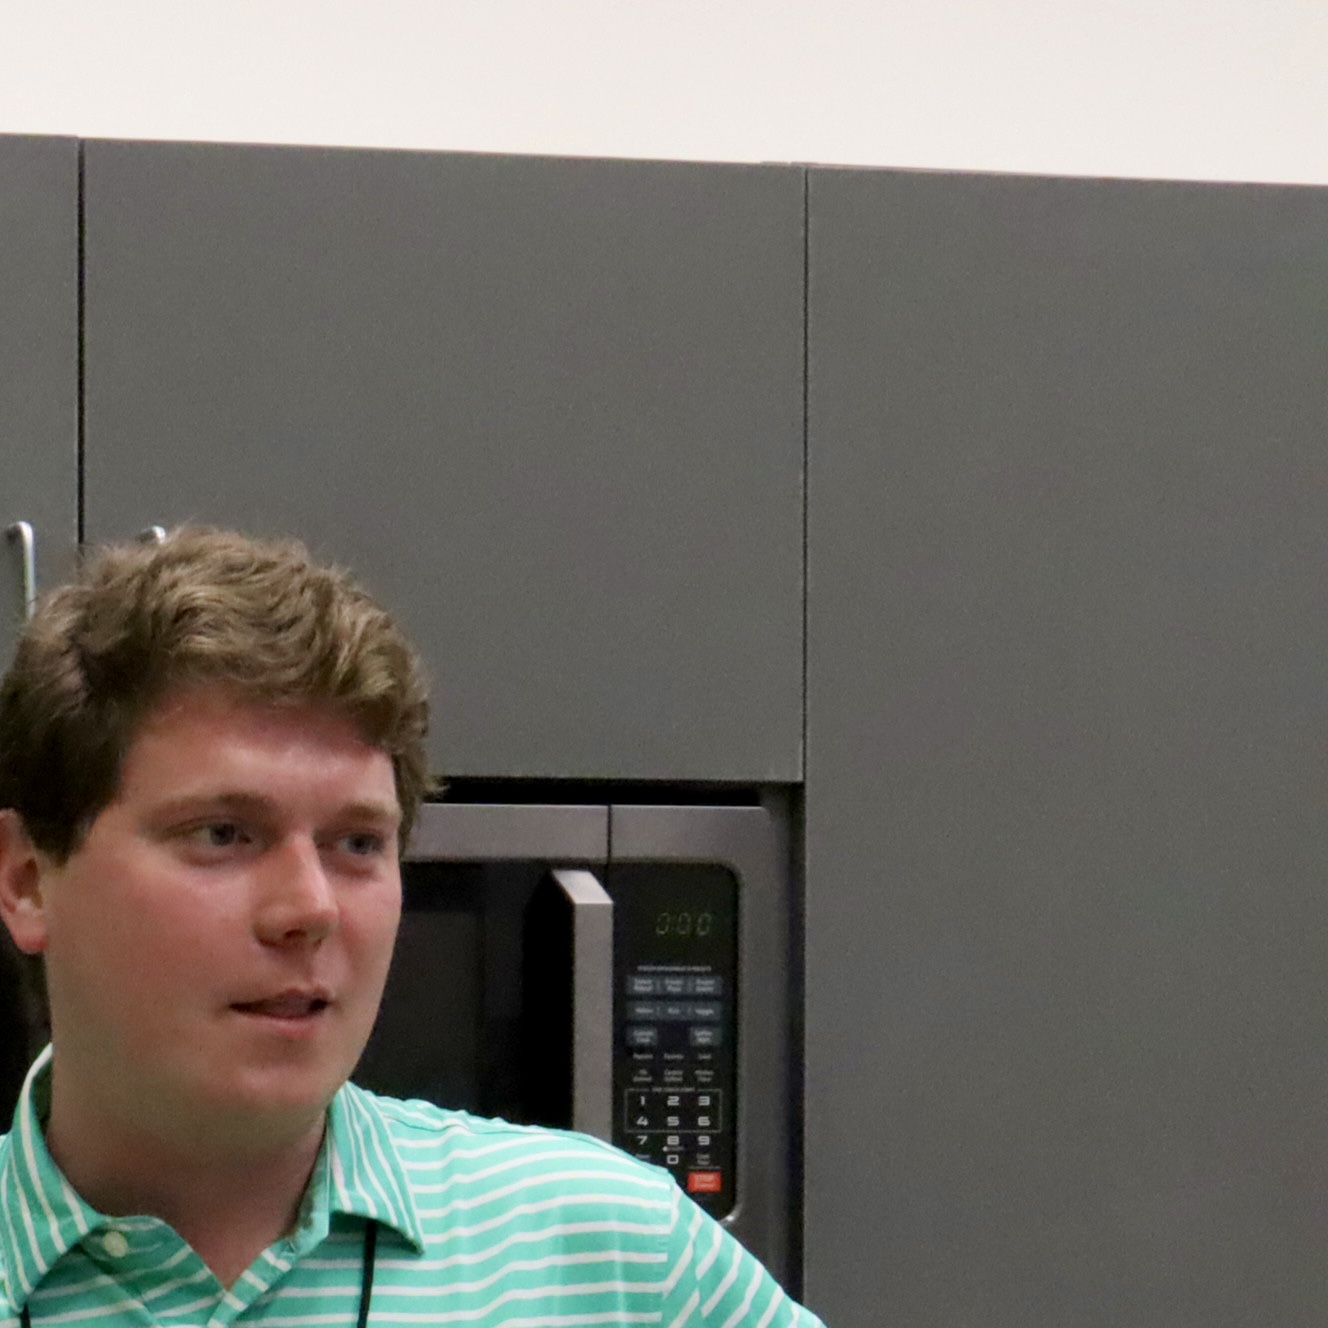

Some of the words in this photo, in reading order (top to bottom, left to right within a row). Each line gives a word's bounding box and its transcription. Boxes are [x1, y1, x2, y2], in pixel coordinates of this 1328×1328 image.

[639, 1096, 646, 1106] 1
[666, 1096, 680, 1106] 2
[697, 1096, 711, 1106] 3
[636, 1116, 649, 1127] 4
[666, 1116, 680, 1127] 5
[697, 1116, 711, 1127] 6
[636, 1135, 649, 1146] 7
[666, 1135, 680, 1146] 8
[697, 1135, 711, 1146] 9
[666, 1154, 680, 1165] 0
